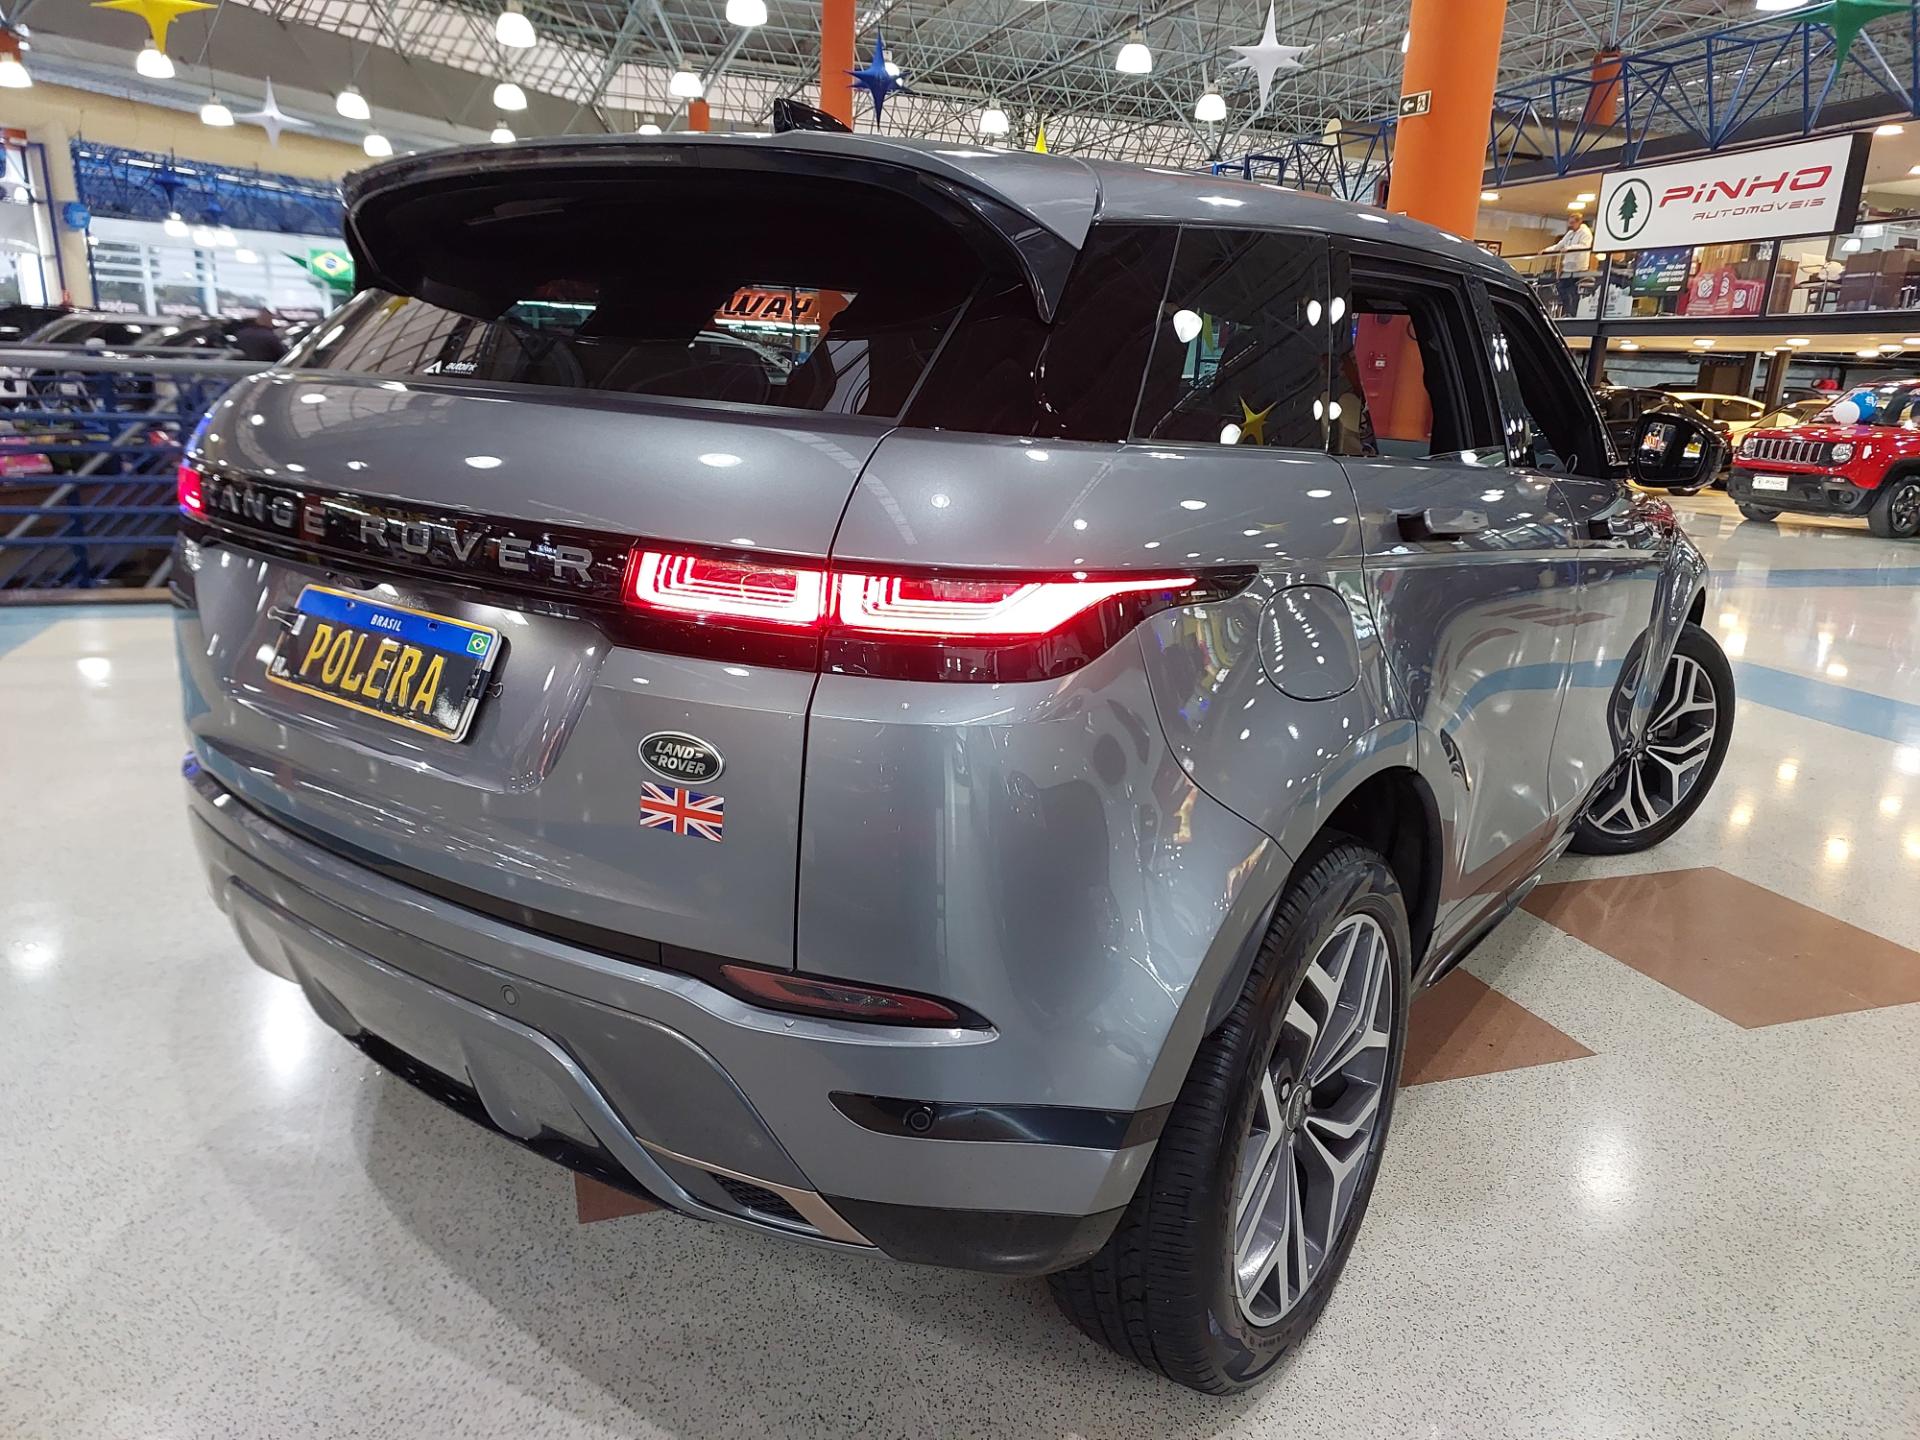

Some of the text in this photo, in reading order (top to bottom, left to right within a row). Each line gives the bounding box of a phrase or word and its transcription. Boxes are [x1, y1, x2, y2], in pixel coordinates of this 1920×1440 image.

[1659, 166, 1832, 208] PINHO
[359, 516, 593, 583] ROVER
[370, 614, 402, 632] BRASIL
[299, 623, 446, 715] POLERA
[655, 741, 695, 759] LAND
[657, 755, 706, 775] ROVER
